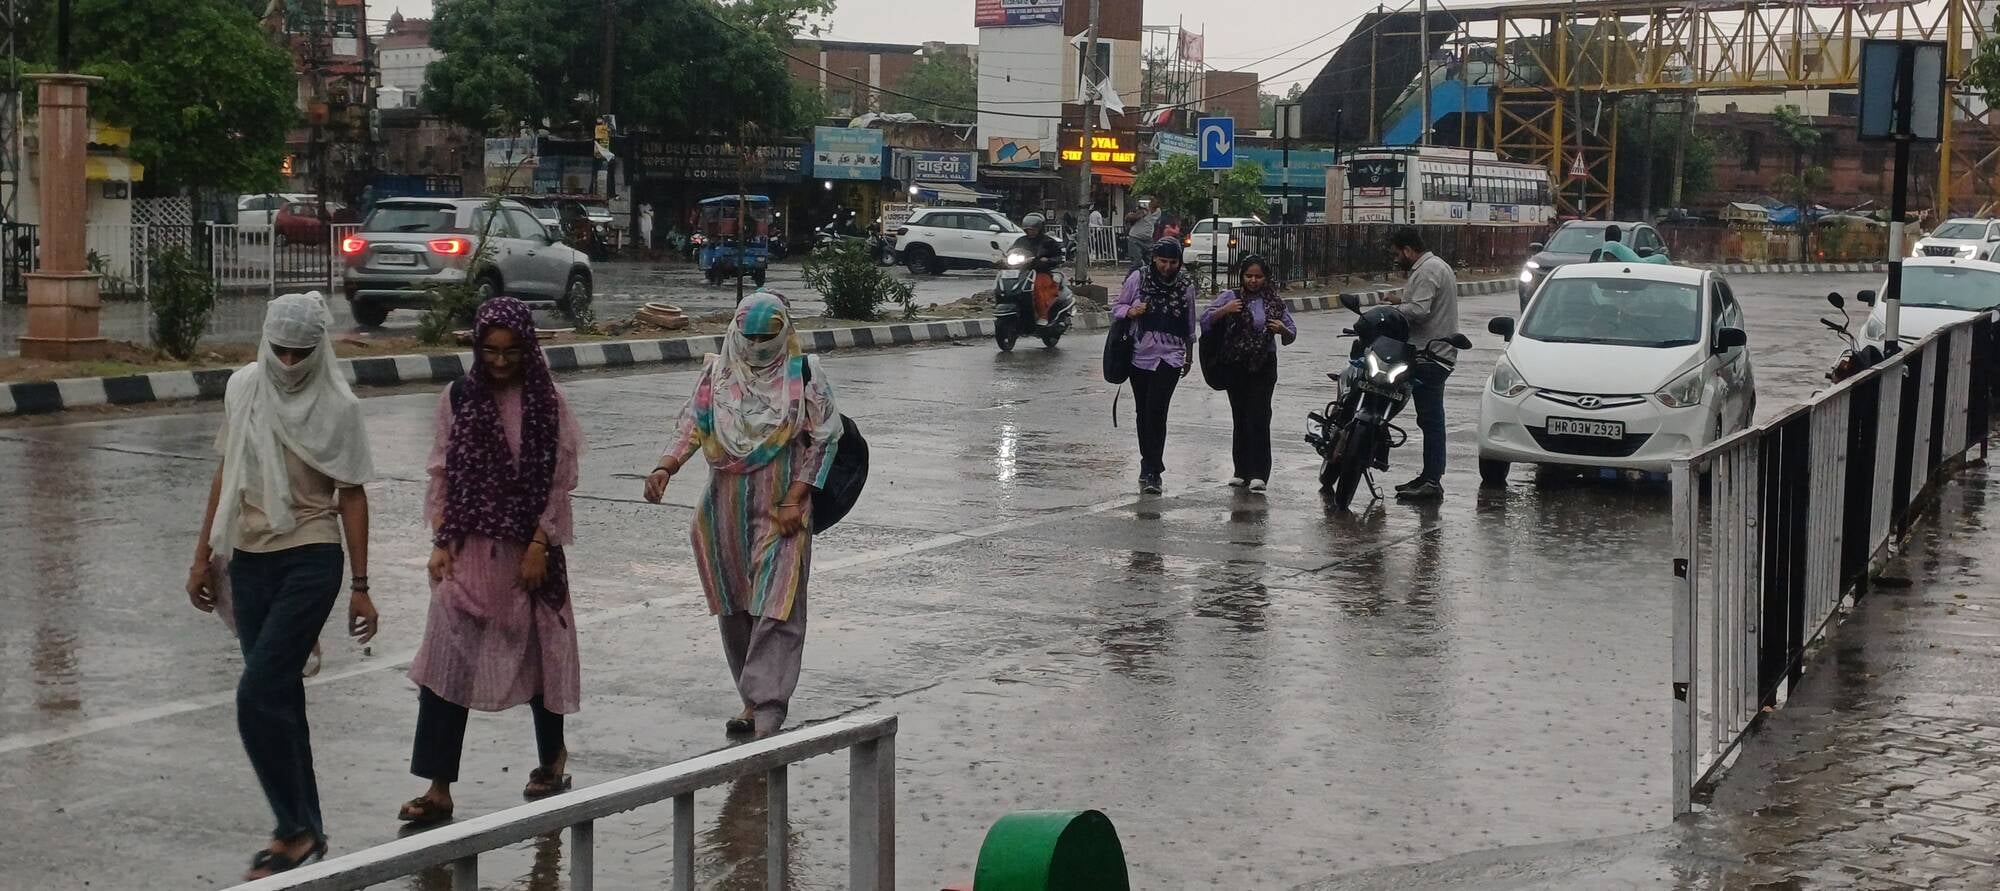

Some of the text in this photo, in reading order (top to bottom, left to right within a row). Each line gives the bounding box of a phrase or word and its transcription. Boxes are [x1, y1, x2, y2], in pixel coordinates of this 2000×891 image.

[1112, 153, 1136, 162] MART
[1554, 421, 1621, 437] HR 03W 2923
